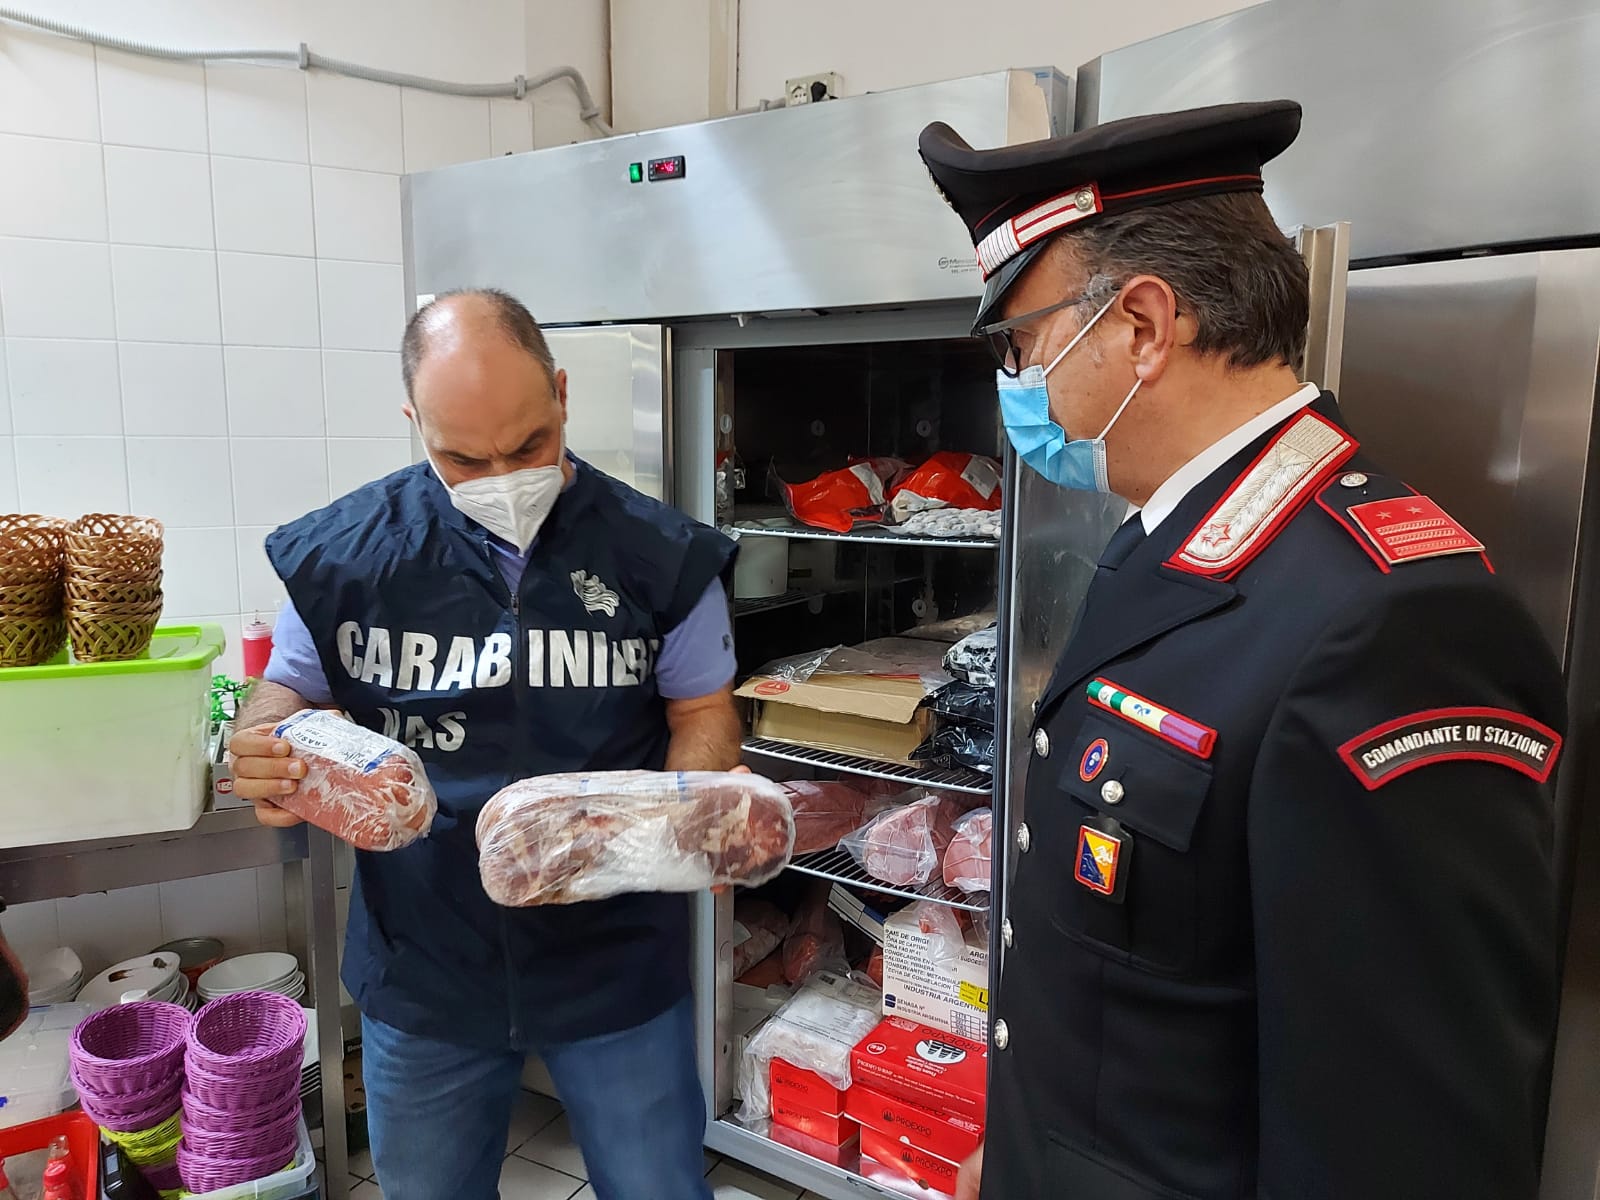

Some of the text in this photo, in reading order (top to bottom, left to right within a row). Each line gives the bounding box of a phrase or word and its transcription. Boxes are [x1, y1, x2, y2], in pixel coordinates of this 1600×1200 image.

[1361, 724, 1548, 770] COMANDANTE DI STAZIONE
[900, 932, 909, 940] DE
[910, 936, 929, 945] ORIG
[903, 984, 941, 1000] INDUSTRIA
[943, 996, 987, 1014] ARGENTINA
[921, 1027, 982, 1053] PROEXPO
[895, 1115, 932, 1137] PROEXPO
[915, 1156, 953, 1177] PROEXPO
